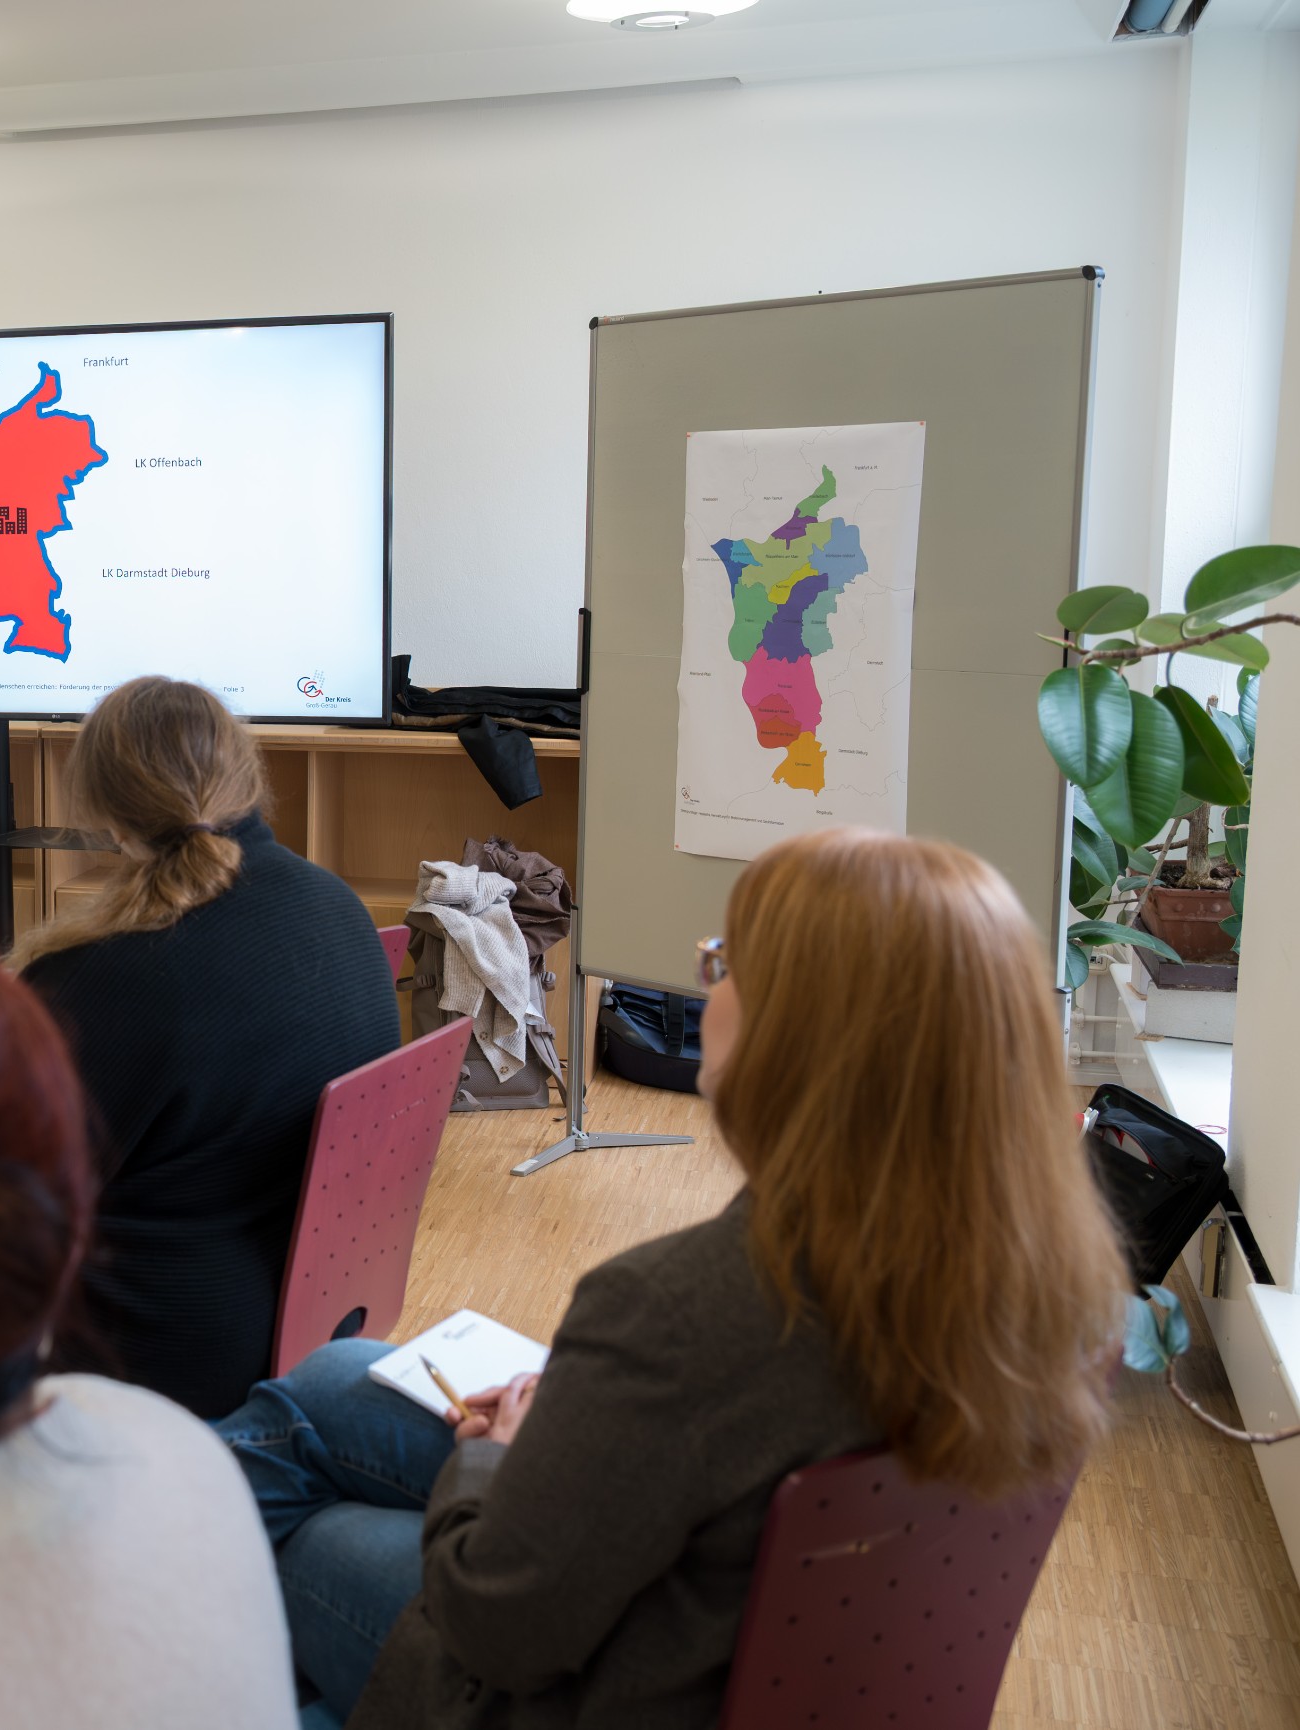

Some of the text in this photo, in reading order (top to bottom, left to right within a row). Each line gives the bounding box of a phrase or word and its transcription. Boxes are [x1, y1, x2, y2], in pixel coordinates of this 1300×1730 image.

[83, 356, 129, 367] Frankfurt
[135, 457, 202, 468] LK Offenbach
[102, 567, 210, 579] LK Darmstadt Dieburg
